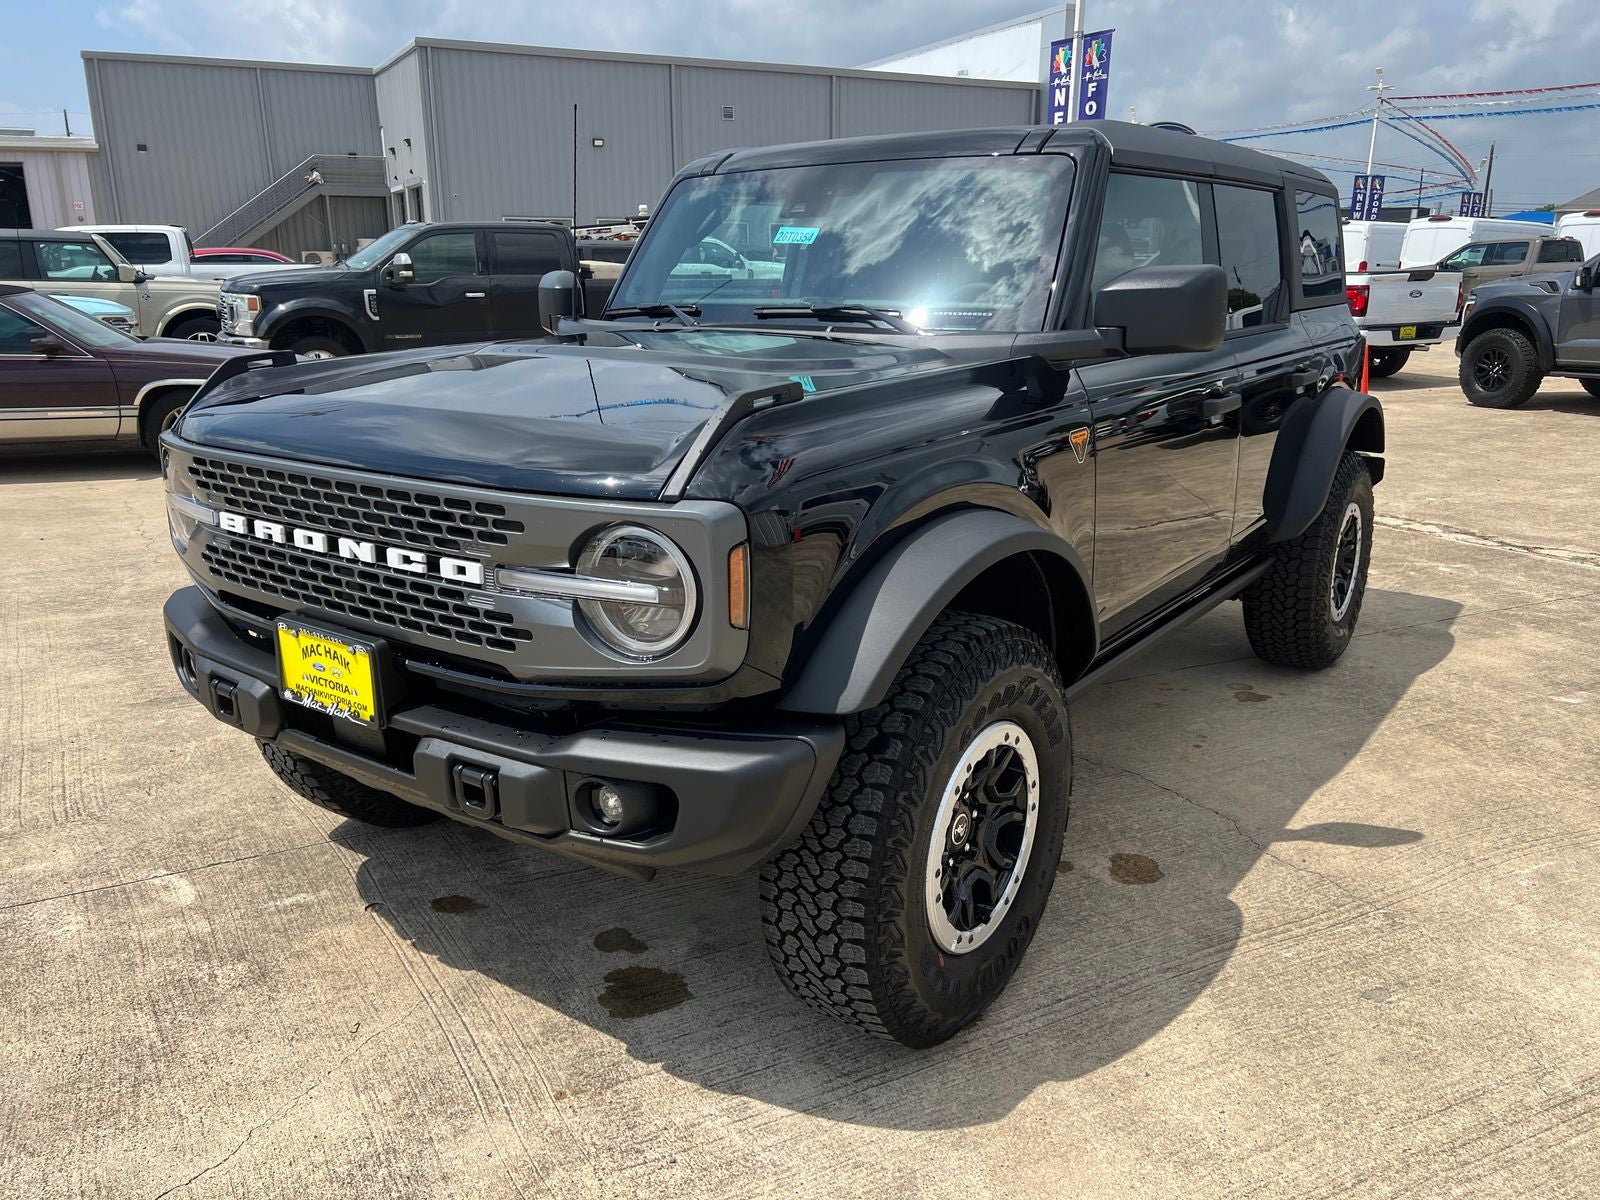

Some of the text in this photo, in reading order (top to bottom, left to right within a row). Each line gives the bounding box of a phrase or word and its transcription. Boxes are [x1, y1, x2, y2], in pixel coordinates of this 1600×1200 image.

[1352, 193, 1363, 219] NEW
[1370, 193, 1380, 220] FORD
[219, 511, 484, 585] BRONCO
[302, 643, 351, 674] MAC HAIK
[295, 683, 368, 712] MACHAIKVICTORIA.COM
[308, 673, 350, 695] VICTORIA
[301, 694, 354, 719] Mac Haik
